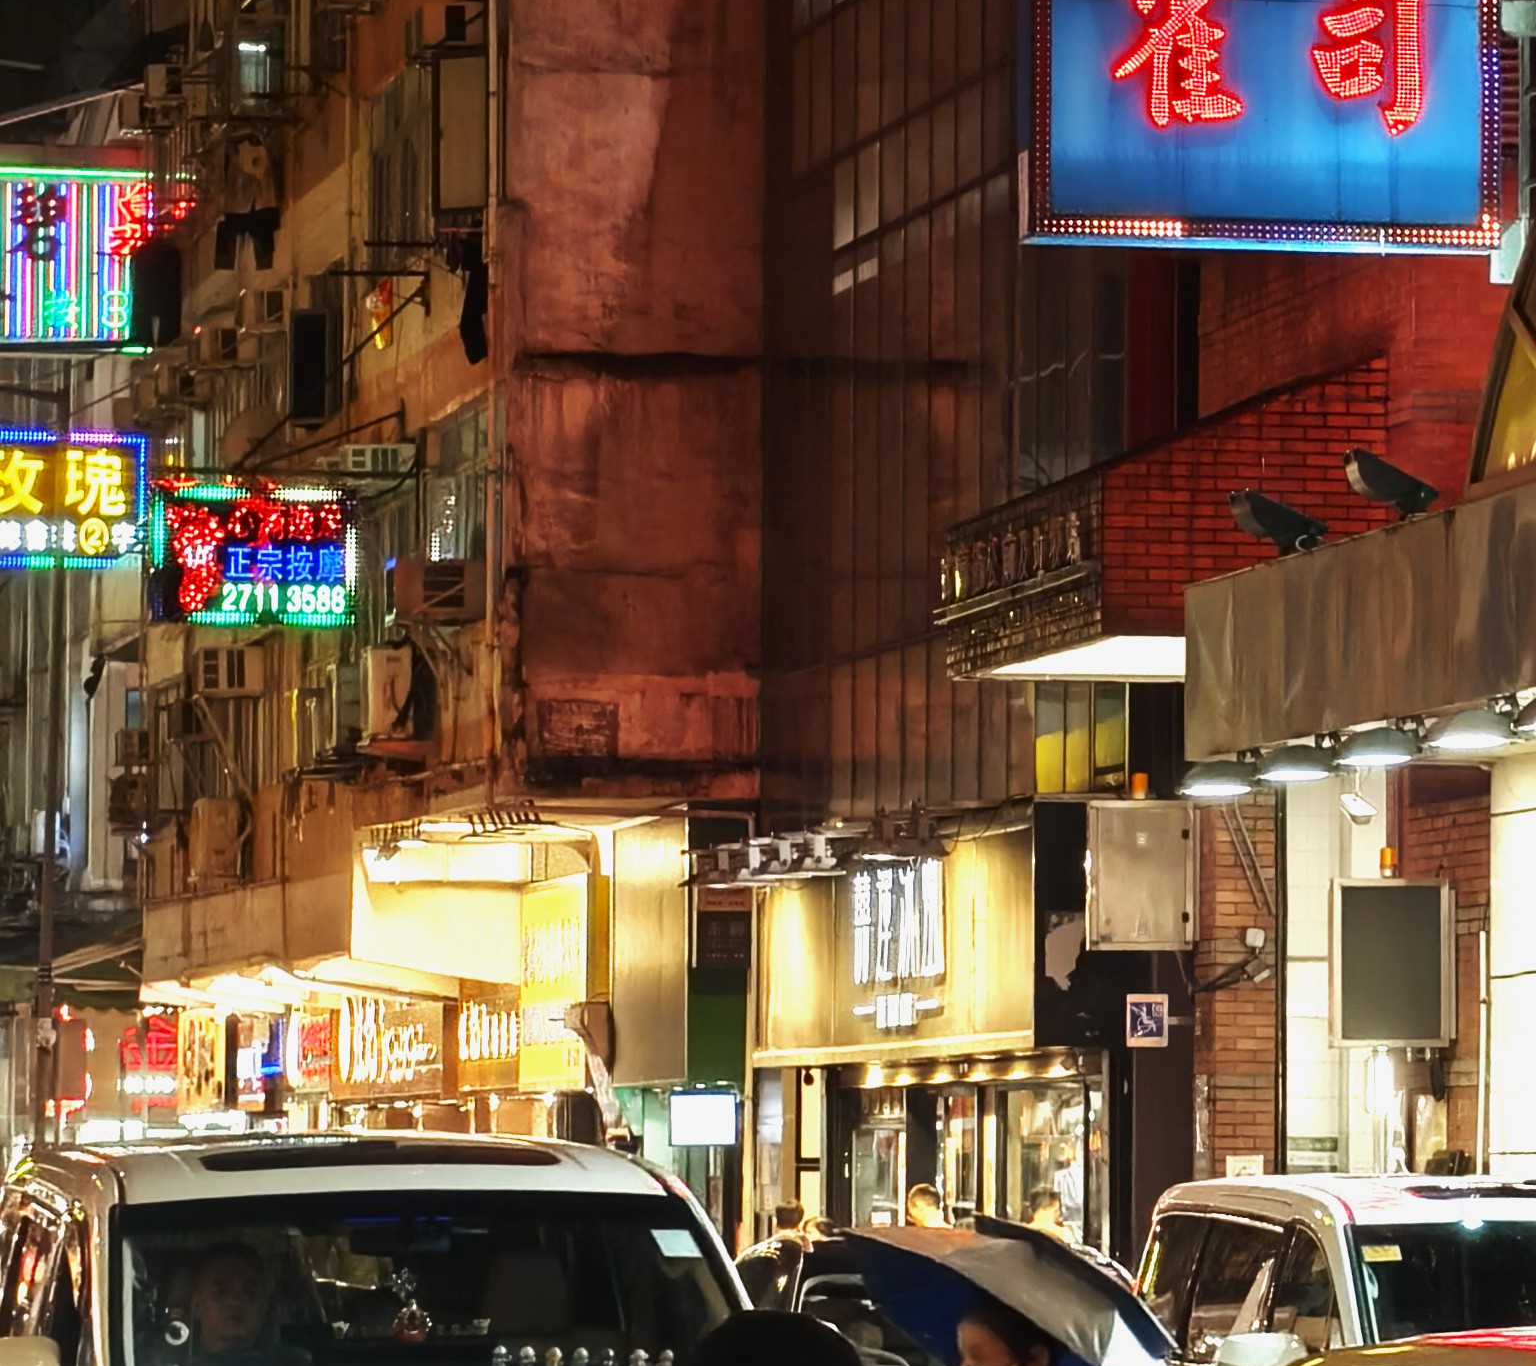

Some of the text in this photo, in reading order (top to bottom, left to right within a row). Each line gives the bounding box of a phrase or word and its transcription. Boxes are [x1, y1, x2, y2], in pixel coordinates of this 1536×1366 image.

[0, 448, 126, 517] 玫瑰
[225, 544, 345, 581] 正宗按摩
[222, 582, 279, 613] 2711
